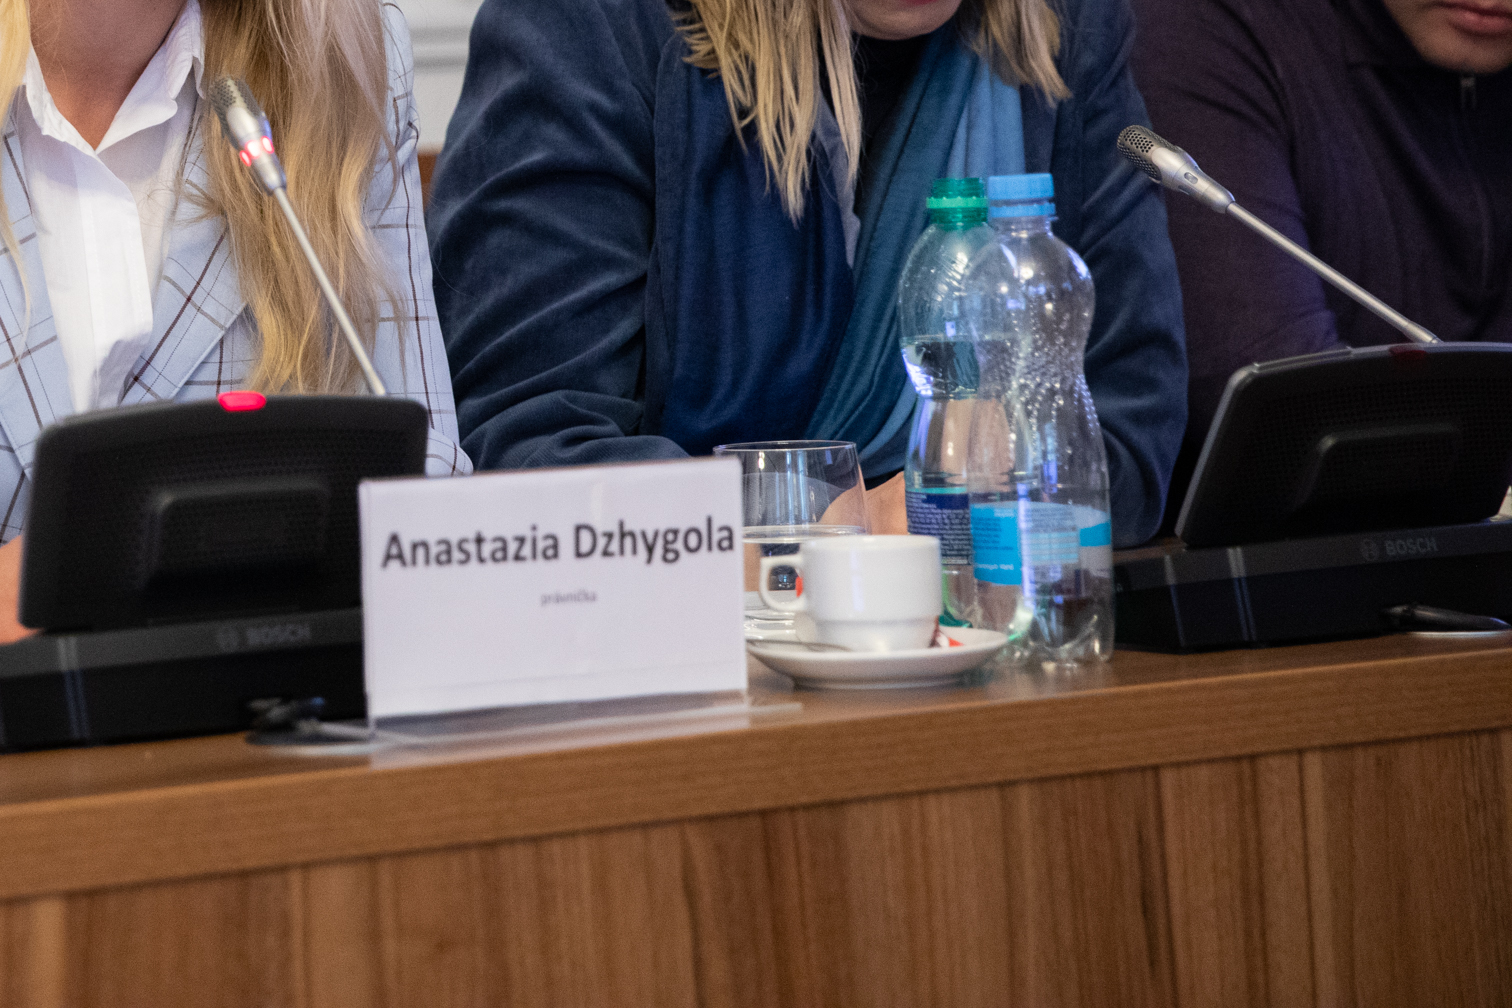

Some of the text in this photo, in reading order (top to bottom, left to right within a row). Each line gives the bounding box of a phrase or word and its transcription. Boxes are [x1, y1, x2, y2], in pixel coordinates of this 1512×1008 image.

[381, 514, 735, 569] Anastazia Dzhygola
[1385, 537, 1438, 556] BOSCH
